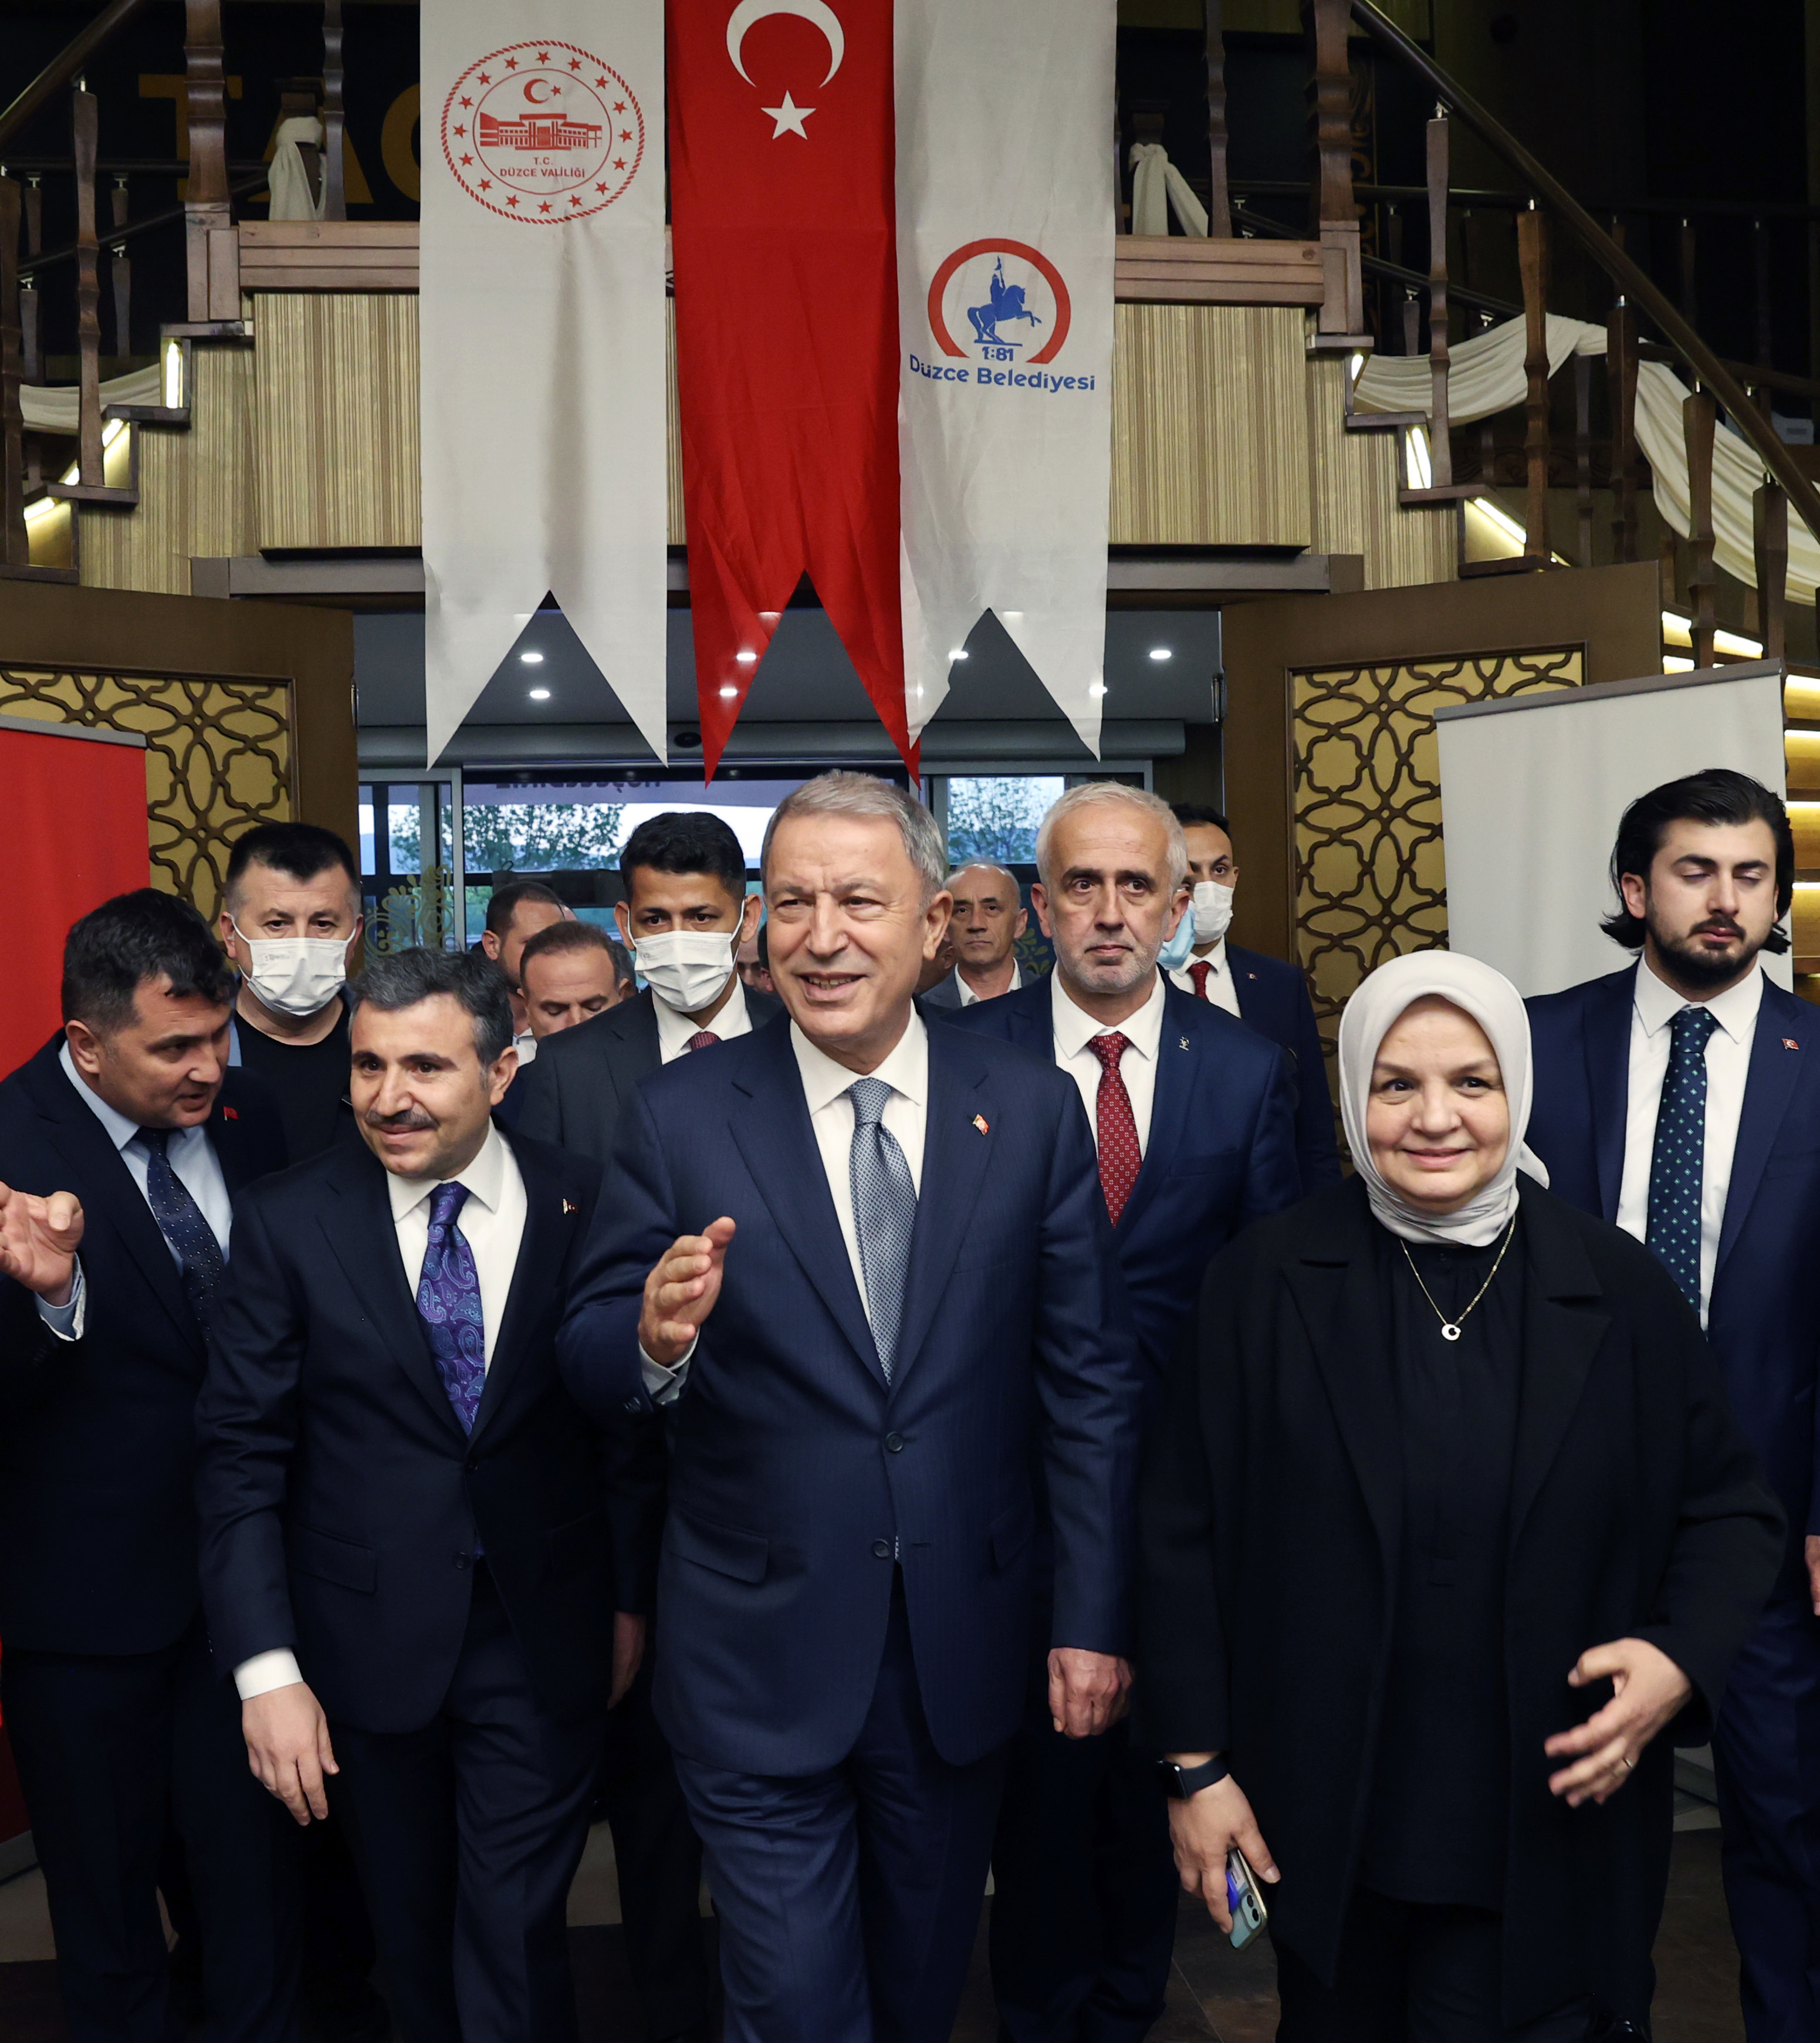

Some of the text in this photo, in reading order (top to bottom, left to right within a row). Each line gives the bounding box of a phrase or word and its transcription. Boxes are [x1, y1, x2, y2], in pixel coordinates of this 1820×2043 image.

[533, 157, 553, 165] T.C.
[499, 167, 537, 177] DÜZCE
[909, 354, 1096, 393] Düzce Belediyesi
